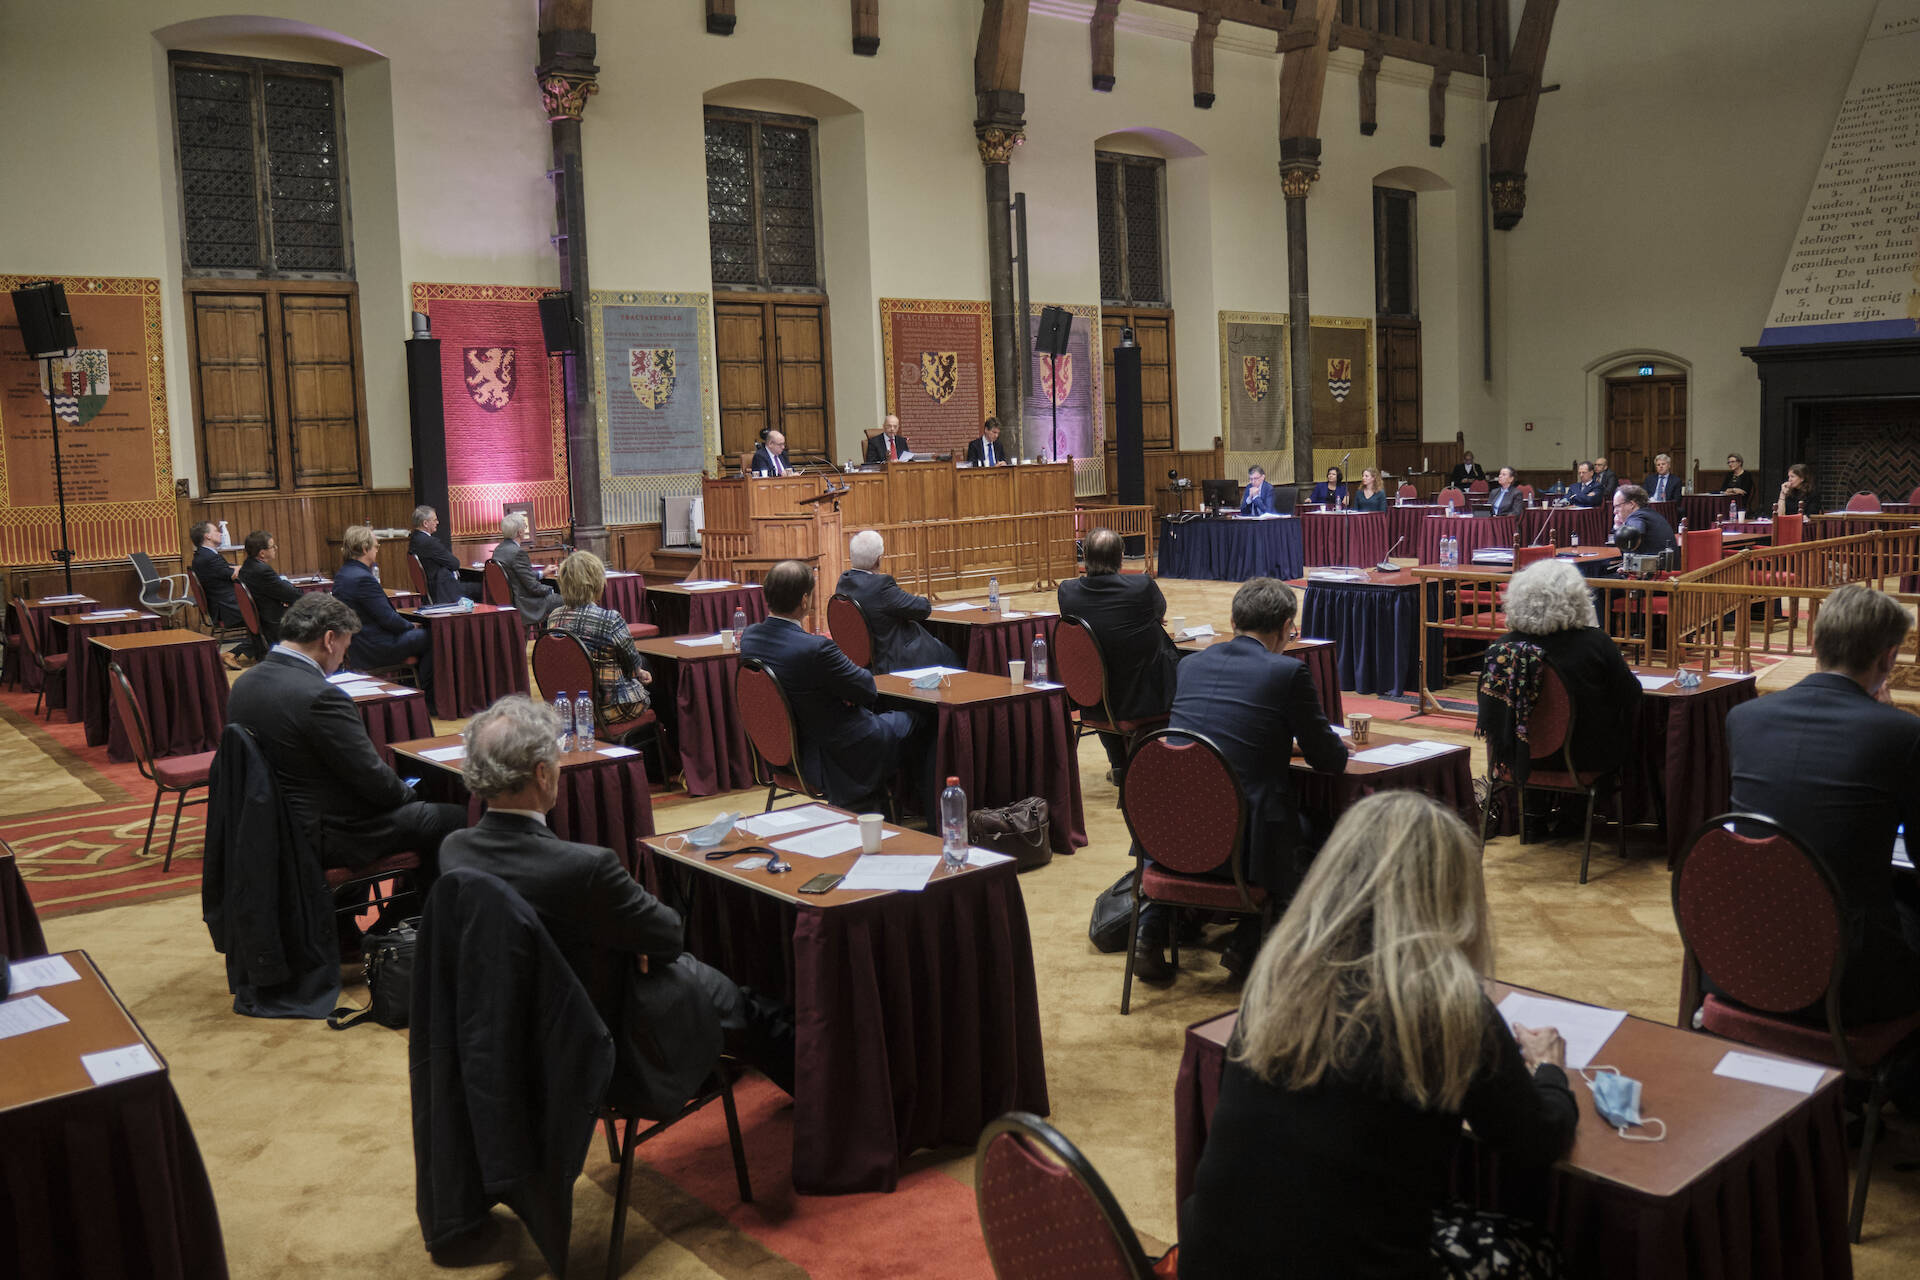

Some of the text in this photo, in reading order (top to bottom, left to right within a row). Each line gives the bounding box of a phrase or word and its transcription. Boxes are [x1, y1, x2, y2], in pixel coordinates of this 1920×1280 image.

[1837, 169, 1854, 177] De
[1831, 190, 1843, 198] 3.
[1859, 185, 1893, 194] Allen
[1869, 192, 1905, 204] hetzij
[1807, 207, 1873, 222] aanspraak
[1881, 206, 1898, 216] op
[1820, 223, 1837, 232] De
[1850, 219, 1874, 228] wet
[1875, 230, 1892, 238] en
[1902, 224, 1920, 234] de
[1796, 239, 1913, 258] aanzien van hun
[1791, 256, 1865, 273] gendheden
[1836, 269, 1856, 279] De
[1785, 279, 1875, 296] wet bepaald.
[1797, 298, 1810, 309] 5.
[1828, 296, 1853, 306] Om
[1862, 290, 1902, 304] eenig
[1775, 305, 1886, 323] derlander zijn.
